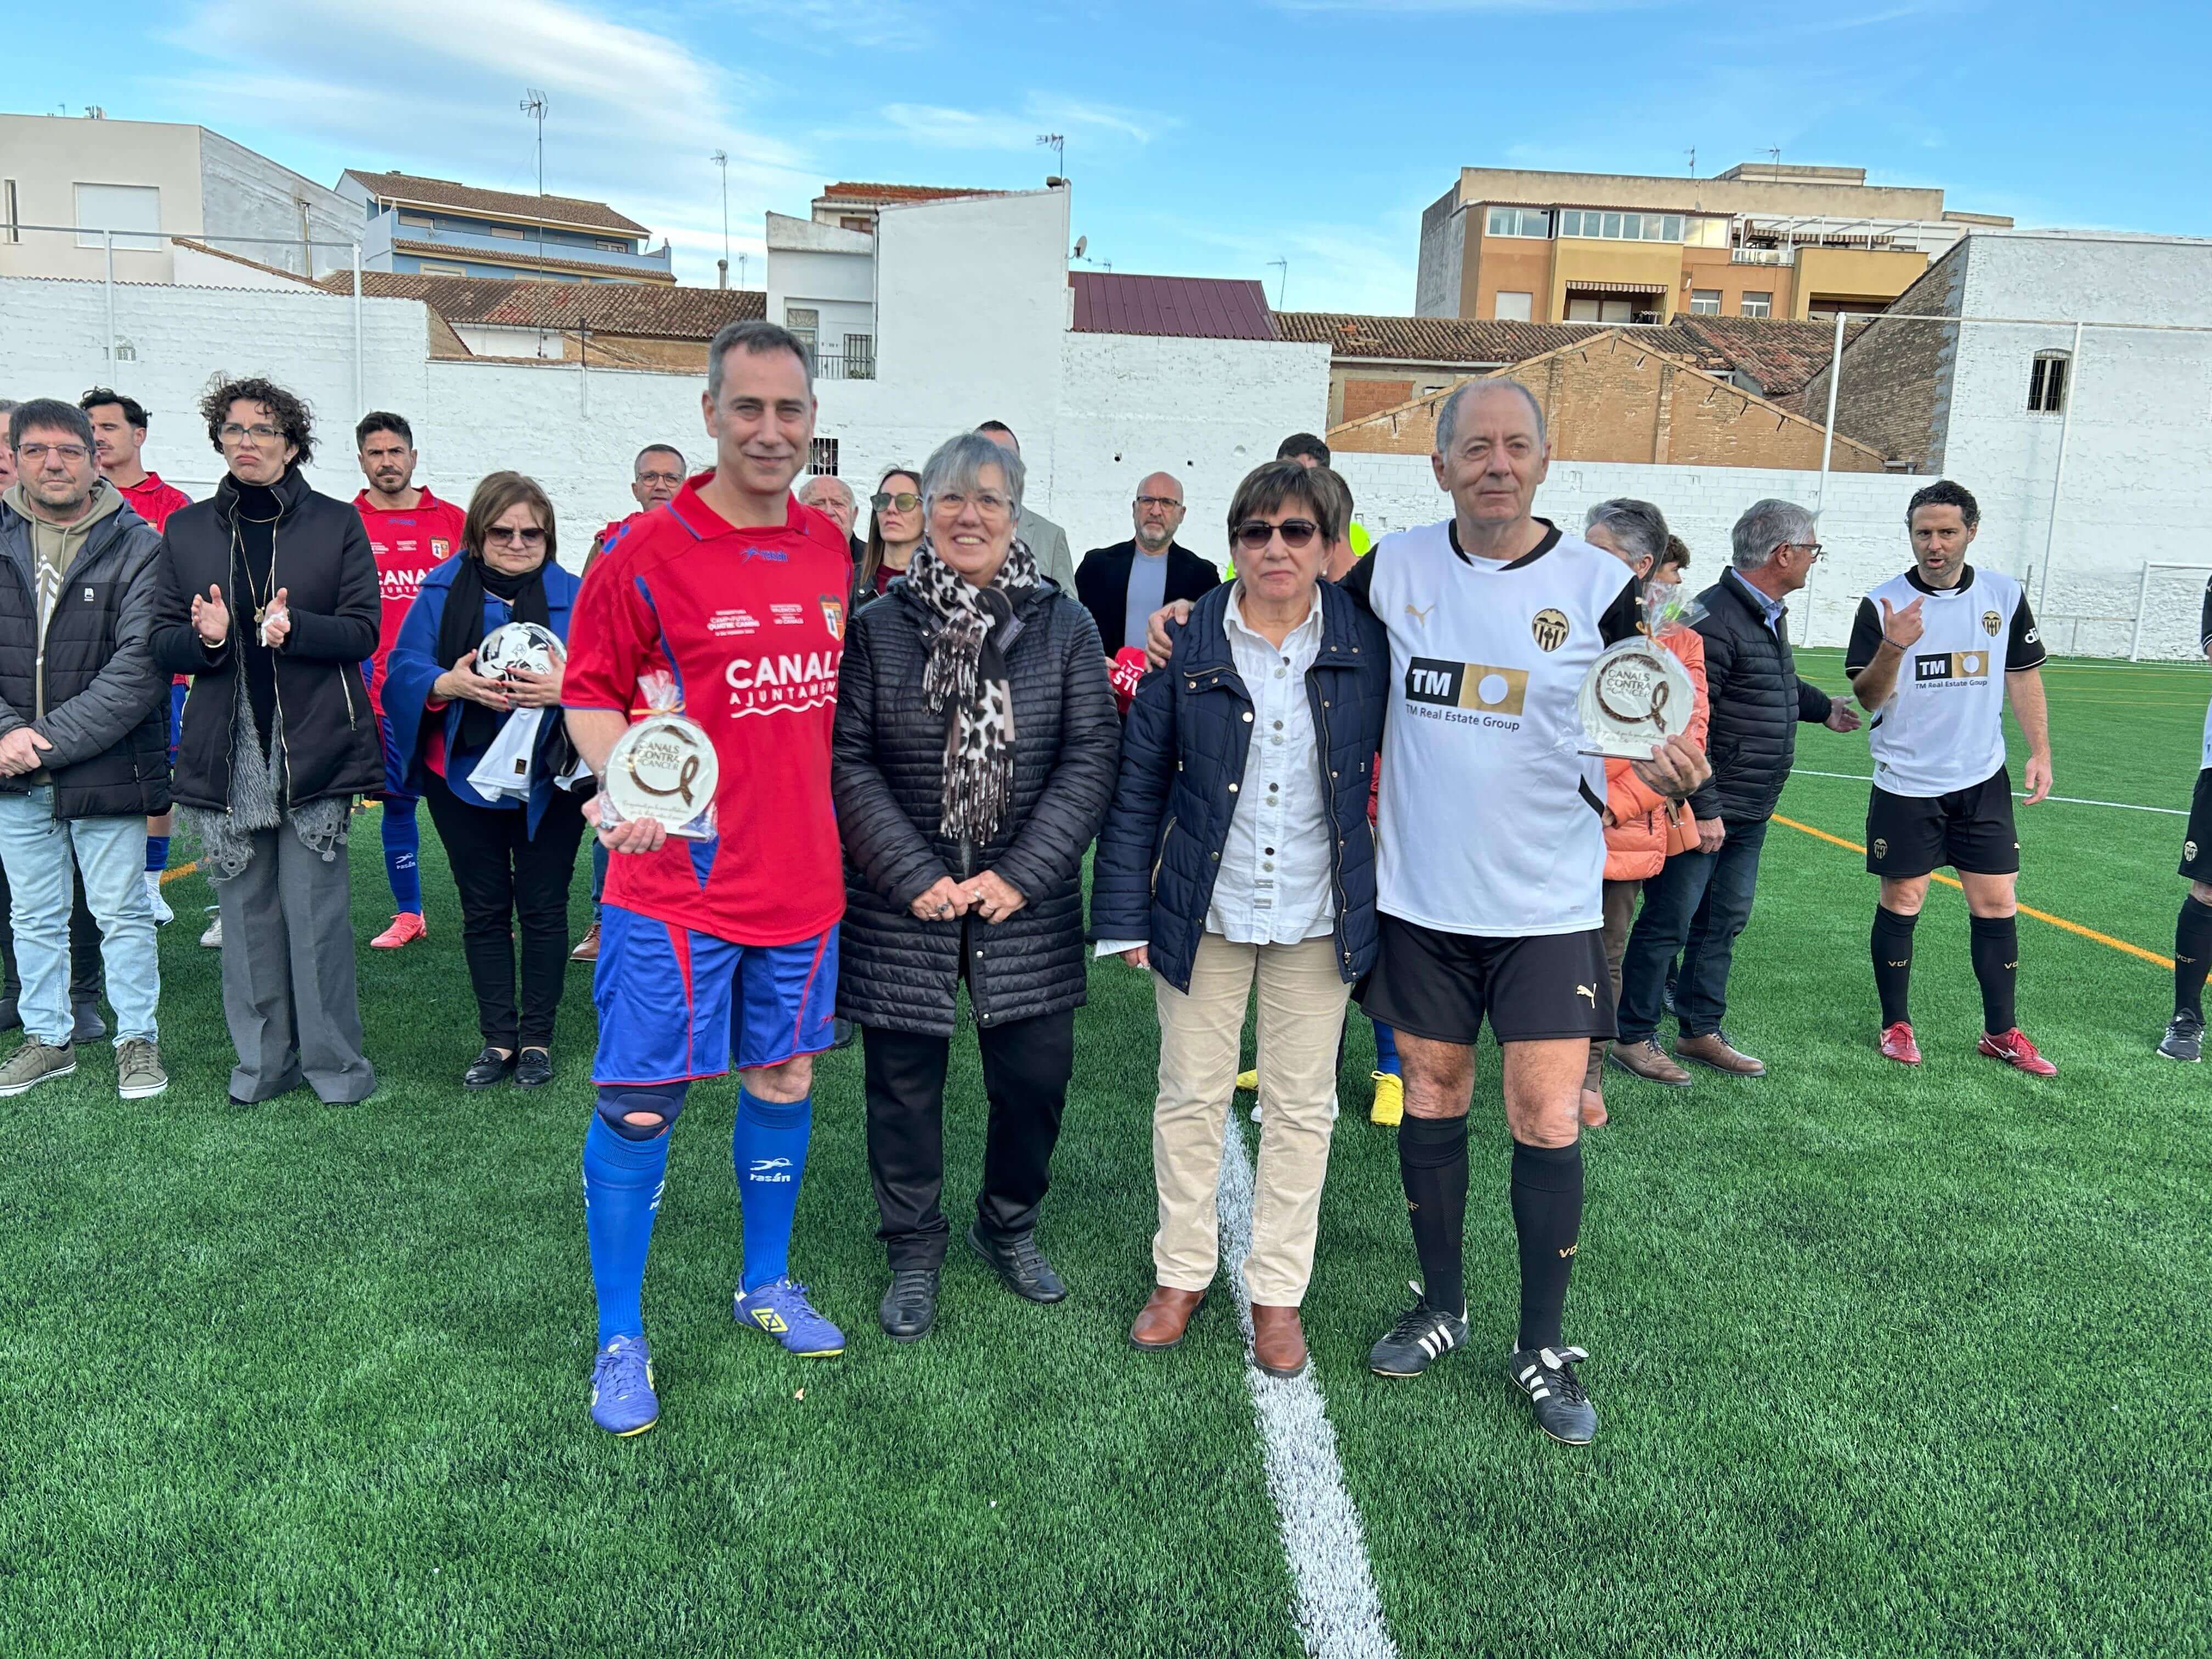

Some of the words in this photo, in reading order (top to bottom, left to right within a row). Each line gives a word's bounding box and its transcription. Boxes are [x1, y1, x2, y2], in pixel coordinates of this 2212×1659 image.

[377, 568, 434, 585] ANA
[1919, 660, 1945, 676] TM
[1608, 669, 1650, 681] CANALS
[1412, 668, 1452, 697] TM
[1606, 679, 1651, 691] CONTRA
[1405, 704, 1417, 715] TM
[1420, 708, 1442, 720] Real
[1445, 712, 1480, 725] Estate
[1483, 716, 1520, 732] Group
[639, 741, 680, 754] CANALS
[637, 750, 680, 763] CONTRA
[750, 1172, 790, 1182] rasán
